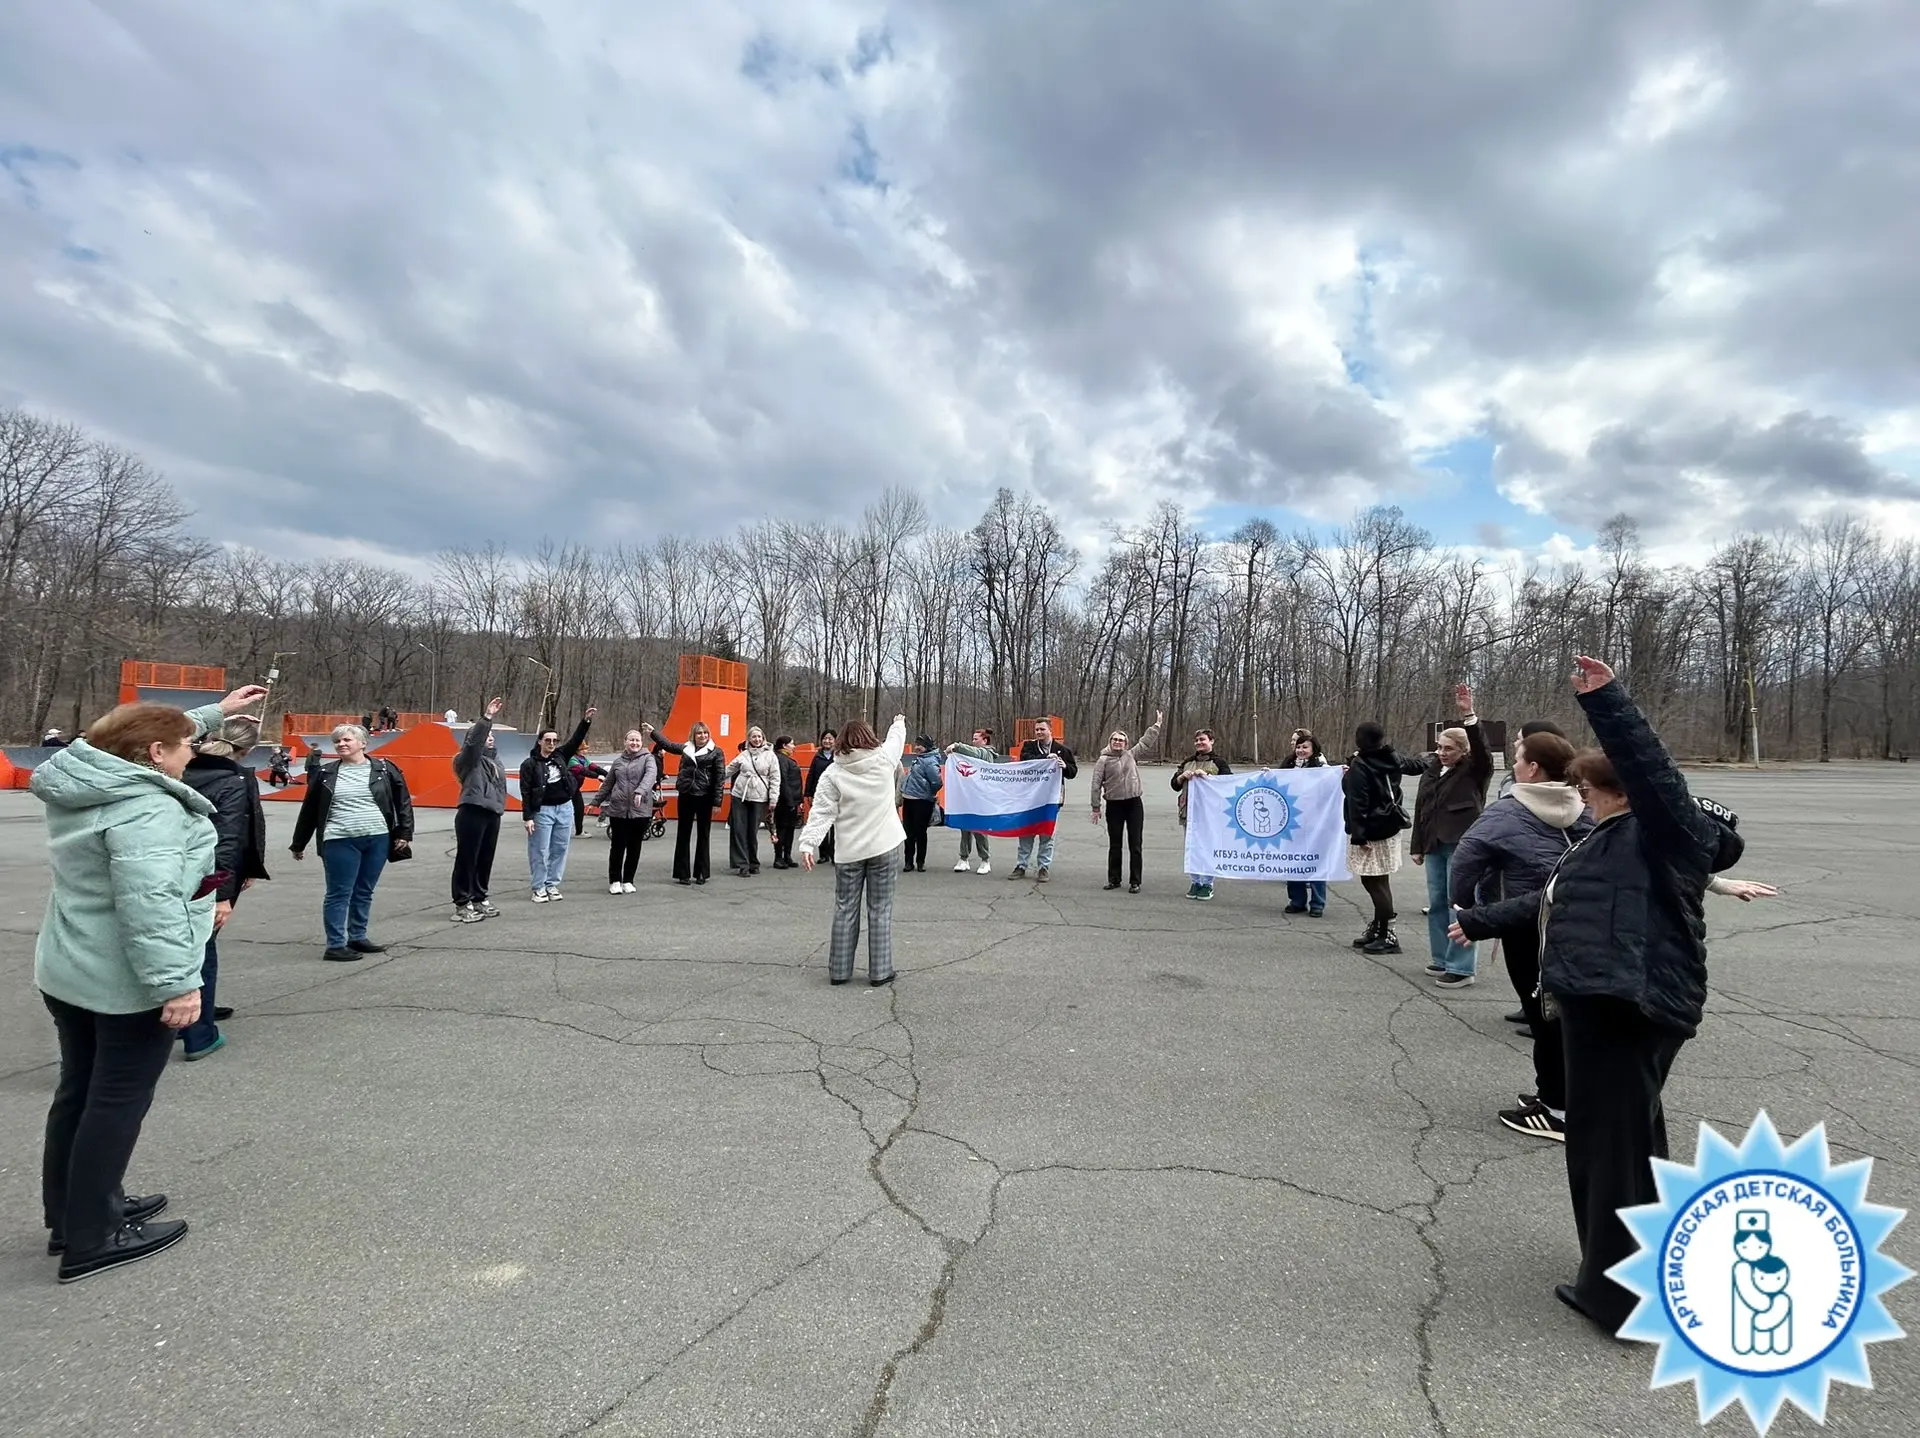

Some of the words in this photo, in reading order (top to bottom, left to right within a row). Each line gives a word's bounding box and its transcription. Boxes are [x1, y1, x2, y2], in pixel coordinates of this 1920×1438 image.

[980, 767, 1016, 775] ПРОФСОЮЗ
[980, 774, 1040, 782] ЗДРАВООХРАНЕНИЯ
[1213, 849, 1238, 859] КГБУЗ
[1215, 863, 1255, 872] детская
[1258, 864, 1317, 874] больница»
